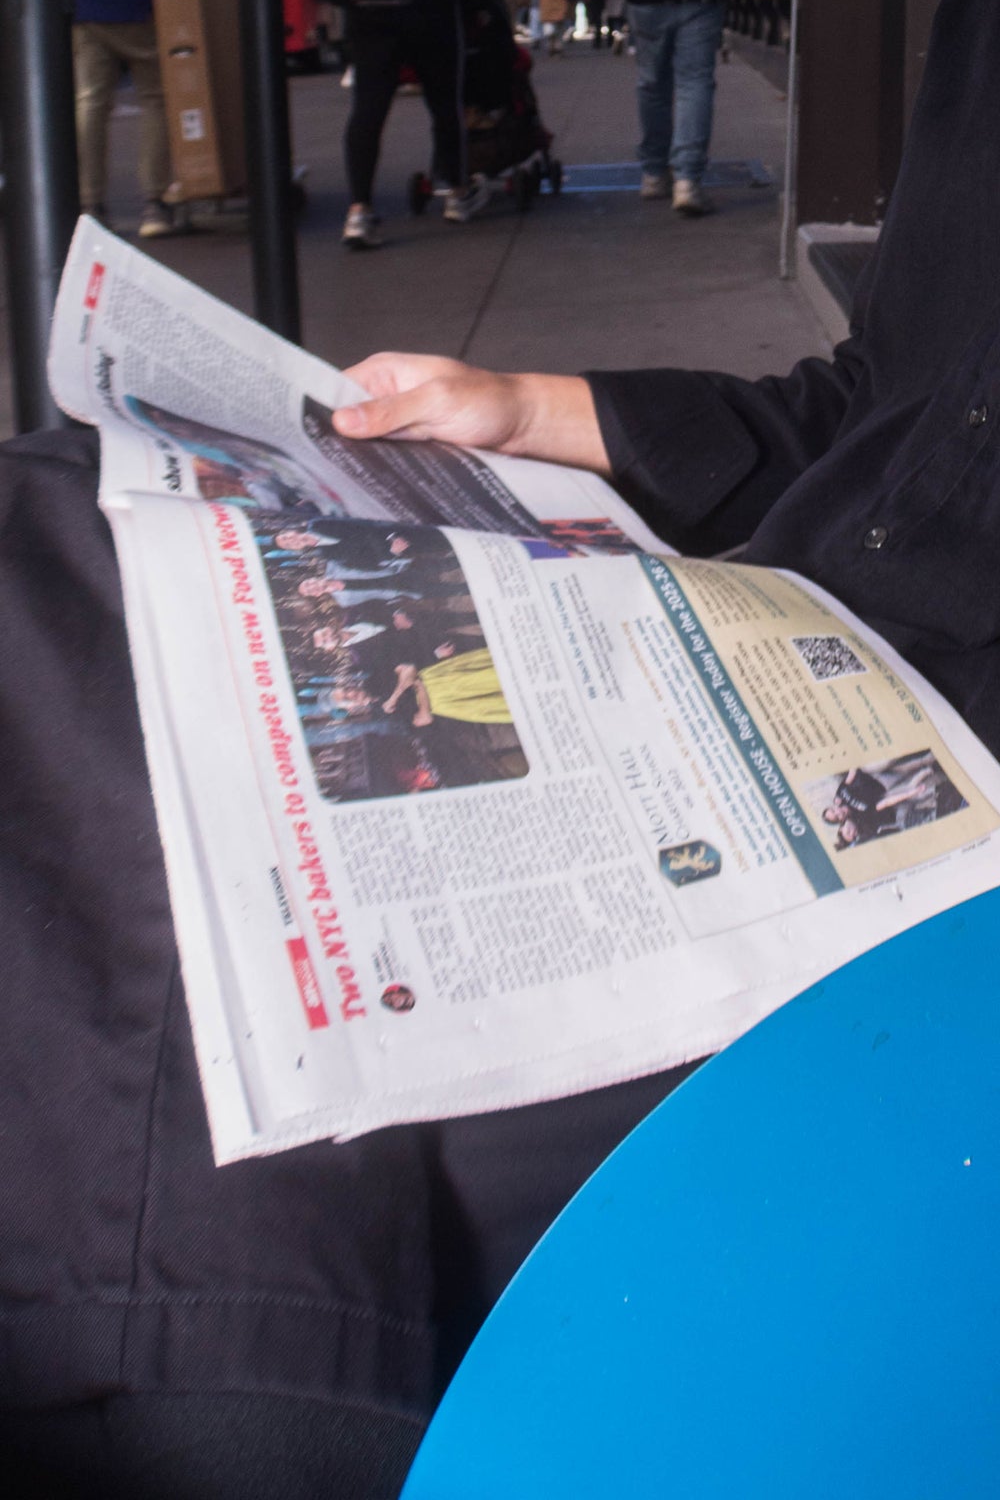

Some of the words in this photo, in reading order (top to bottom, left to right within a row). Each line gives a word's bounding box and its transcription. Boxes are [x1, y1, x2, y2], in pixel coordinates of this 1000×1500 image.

[220, 555, 256, 607] Food
[650, 562, 687, 613] 2025-26
[235, 610, 269, 656] new
[675, 608, 698, 633] the
[686, 630, 708, 654] for
[247, 658, 277, 689] on
[697, 647, 728, 688] Today
[256, 690, 303, 788] compete
[717, 686, 756, 742] Register
[748, 745, 785, 796] HOUSE
[280, 790, 309, 817] to
[774, 792, 808, 837] OPEN
[289, 820, 333, 902] bakers
[312, 904, 350, 962] NYC
[329, 963, 367, 1021] Two
